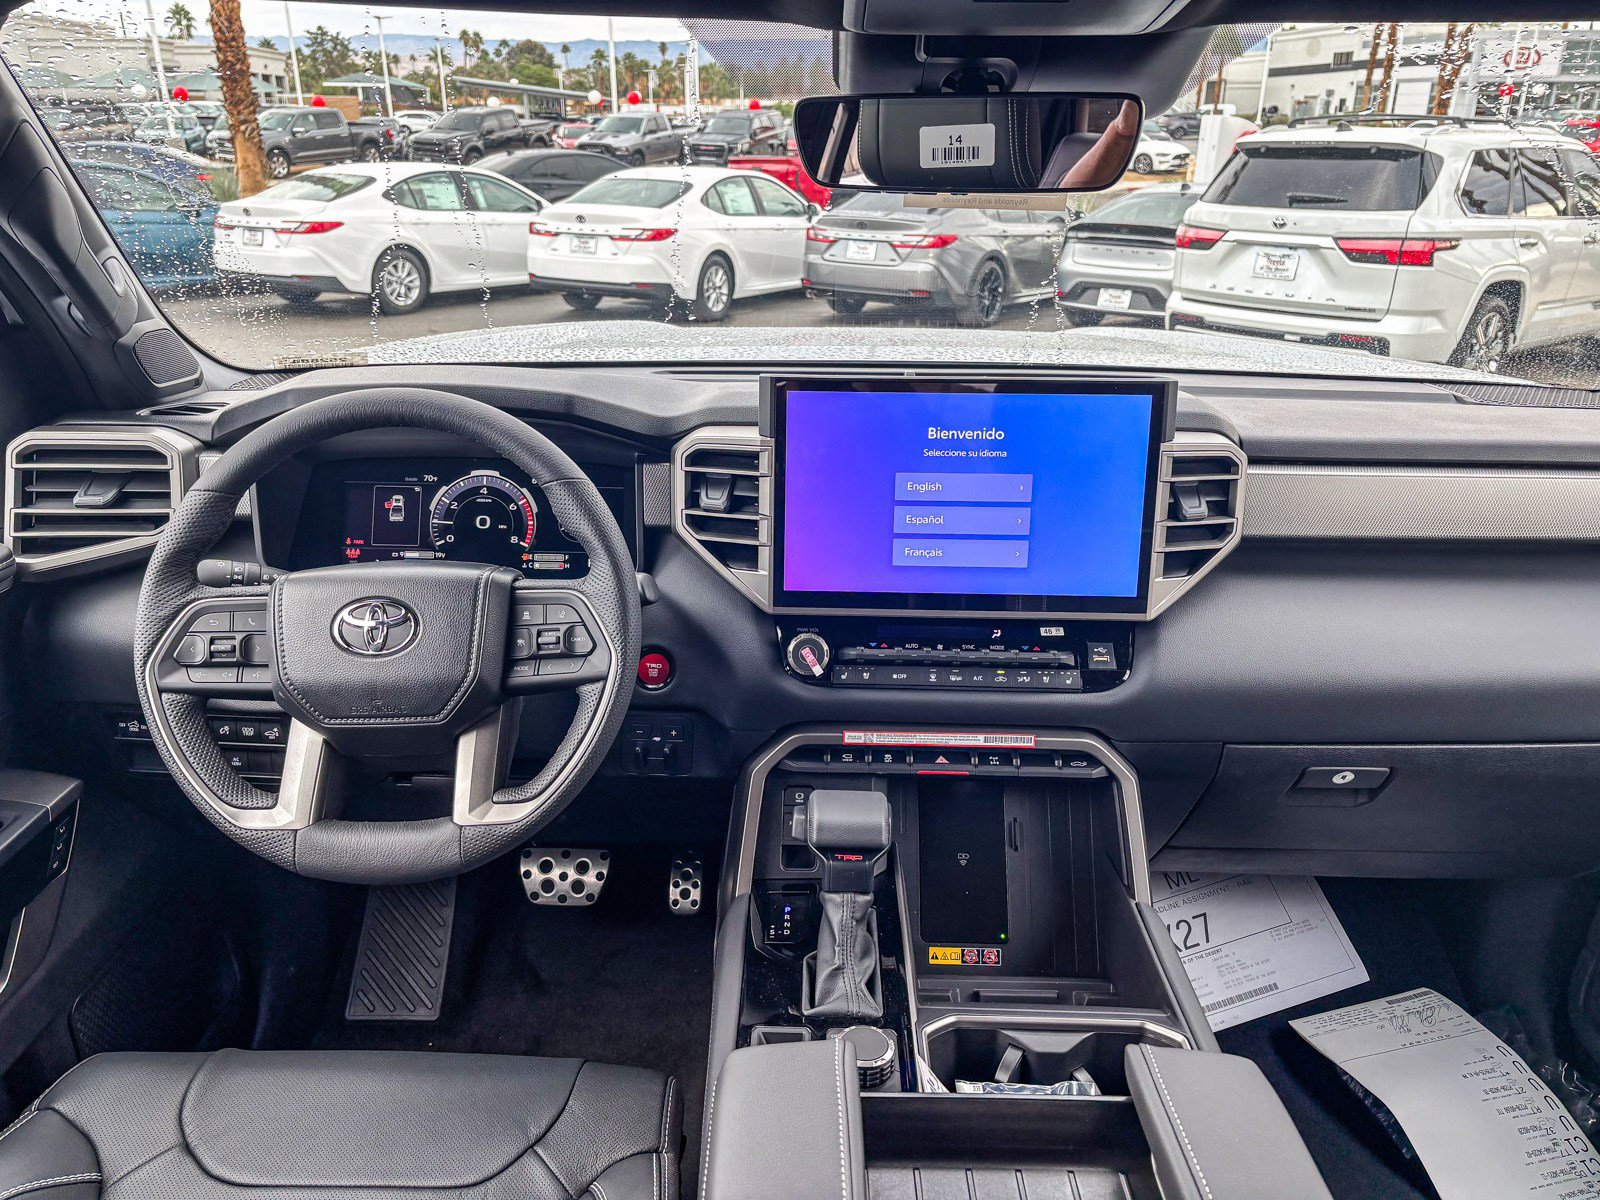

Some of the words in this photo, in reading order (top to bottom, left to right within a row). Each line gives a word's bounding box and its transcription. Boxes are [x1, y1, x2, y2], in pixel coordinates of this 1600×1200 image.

[949, 134, 963, 146] 14
[927, 427, 1005, 440] Bienvenido
[923, 448, 966, 458] Seleccione
[968, 450, 978, 458] su
[979, 449, 1007, 457] idioma
[907, 482, 942, 492] English
[476, 515, 490, 529] 0
[906, 514, 944, 526] Español
[446, 534, 454, 542] 0
[510, 536, 518, 544] 8
[905, 547, 943, 558] Français
[1182, 886, 1231, 906] ASSIGNMENT
[1194, 953, 1204, 961] THE
[1204, 948, 1223, 957] DESERT
[1512, 1060, 1528, 1075] U
[1528, 1076, 1545, 1092] U
[1530, 1105, 1543, 1114] RT
[1544, 1095, 1560, 1111] U
[1558, 1115, 1575, 1132] U
[1563, 1136, 1589, 1155] C1
